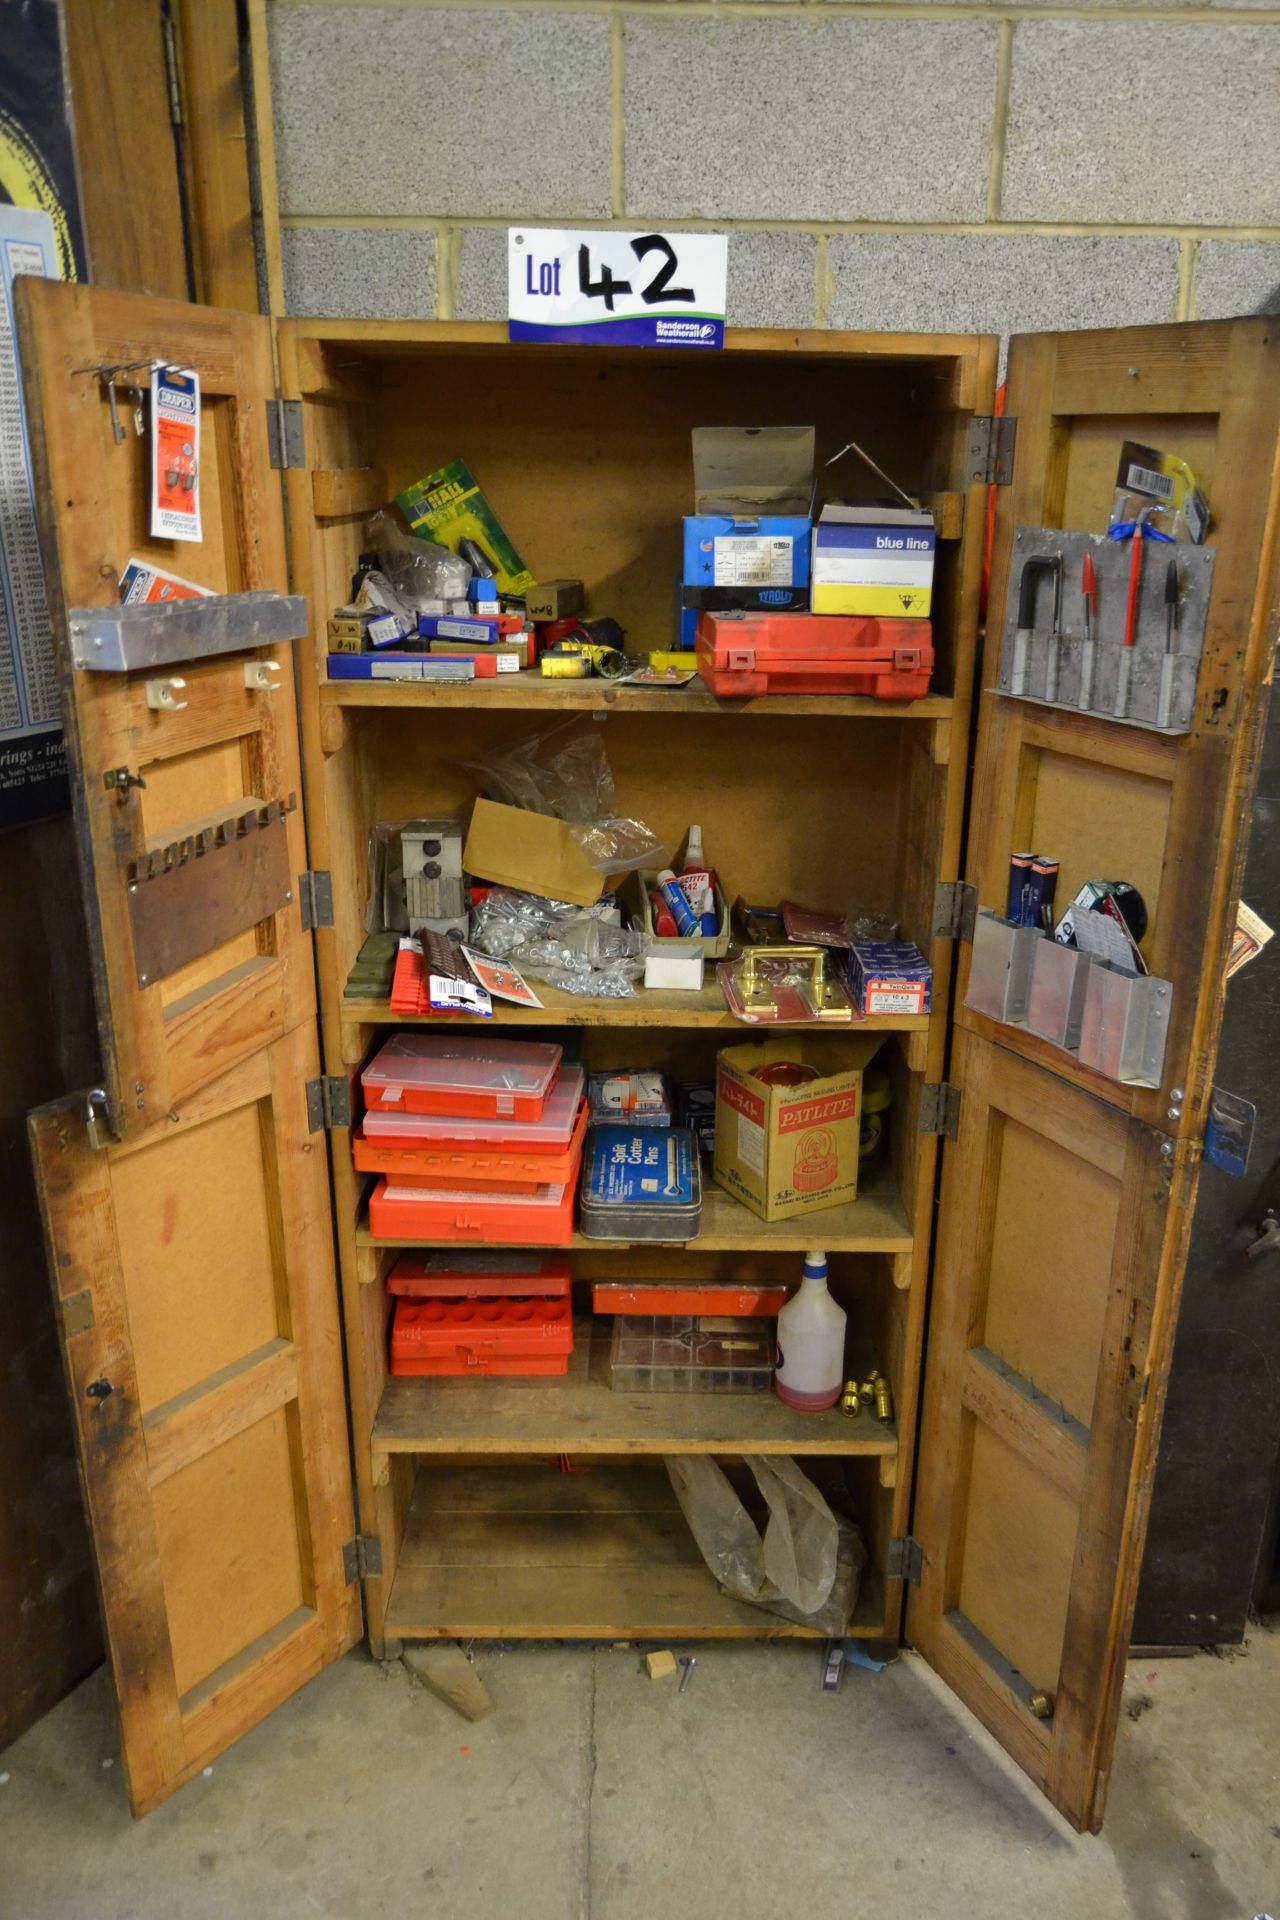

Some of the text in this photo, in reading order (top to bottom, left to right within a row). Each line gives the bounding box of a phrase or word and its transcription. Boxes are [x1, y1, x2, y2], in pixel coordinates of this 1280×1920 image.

[526, 234, 696, 311] Lot 42
[656, 320, 700, 330] Sanderson
[656, 328, 700, 338] Weatherall
[160, 391, 192, 410] DRAPER
[876, 536, 929, 550] blue line
[758, 590, 793, 602] TYROLIT
[780, 1097, 852, 1128] PATLITE
[611, 1143, 629, 1164] Split
[627, 1137, 643, 1165] Cotter
[643, 1146, 659, 1165] Pins
